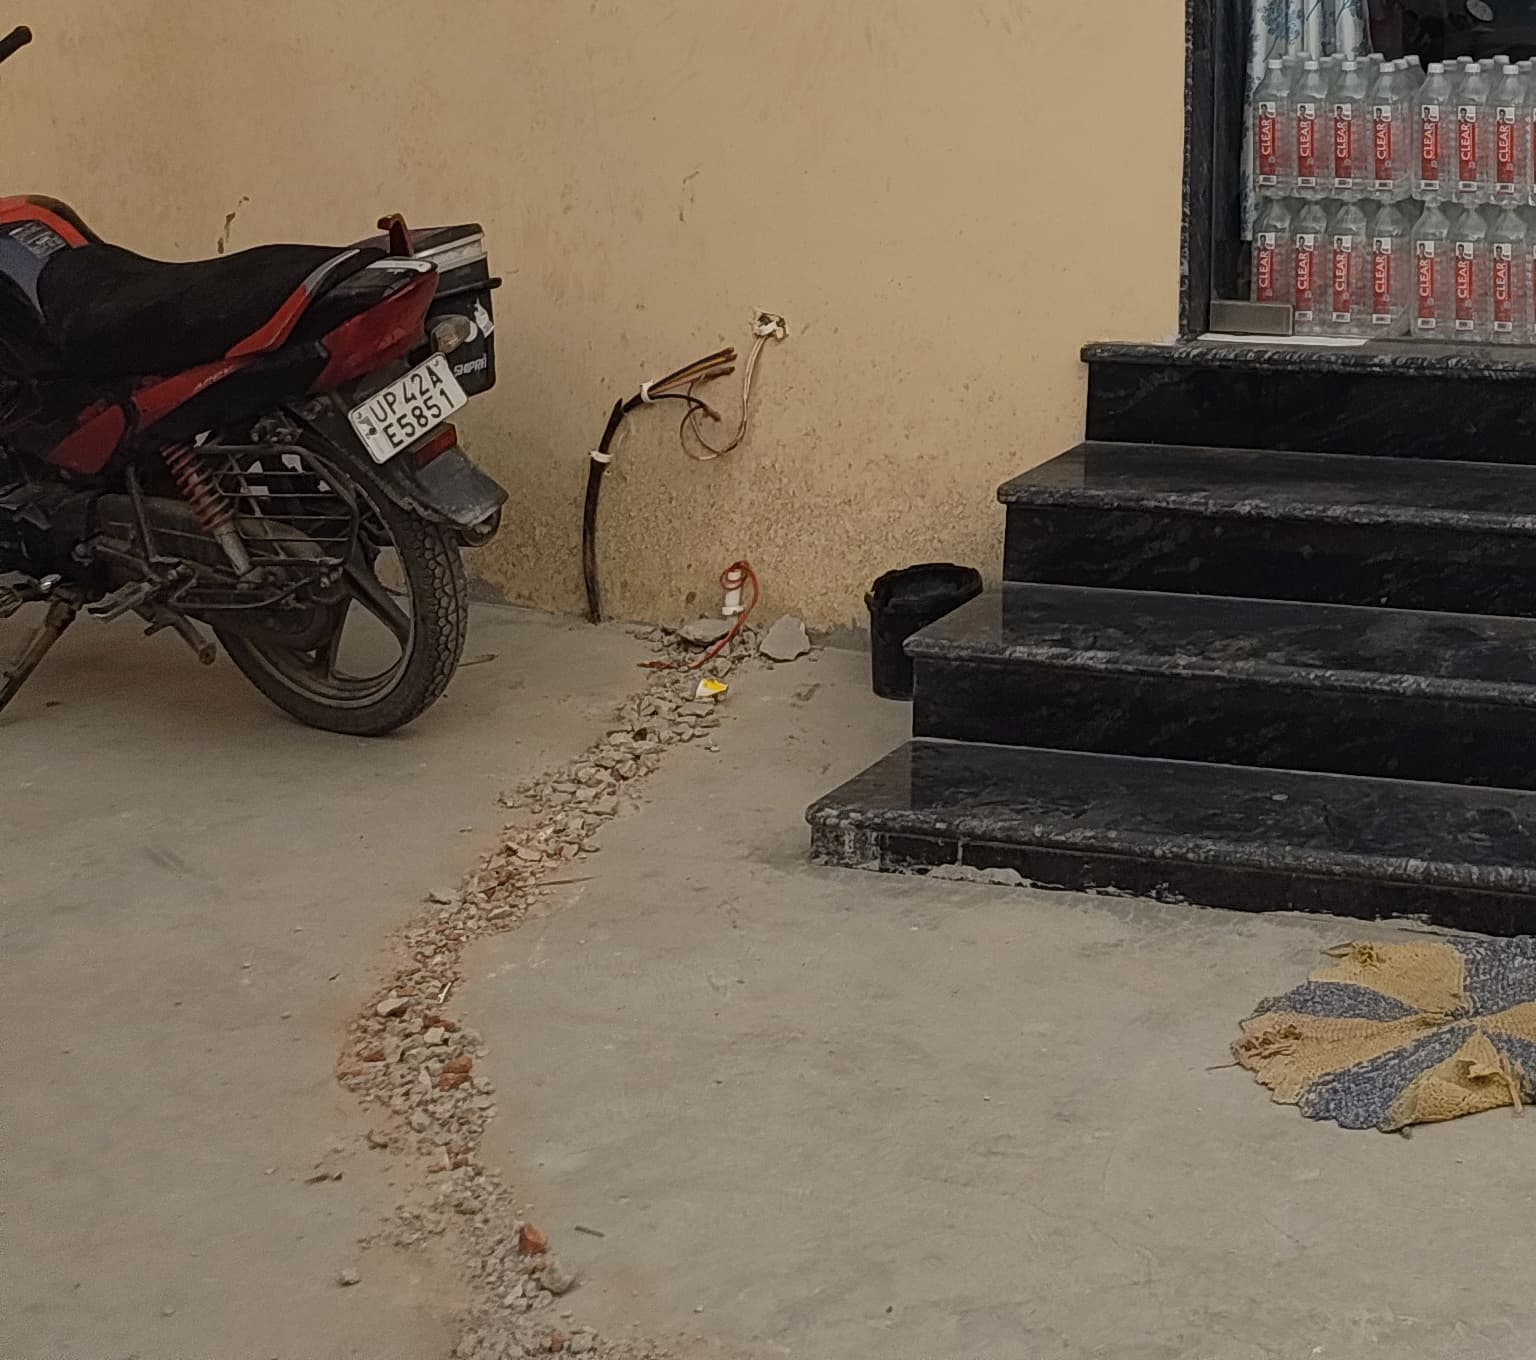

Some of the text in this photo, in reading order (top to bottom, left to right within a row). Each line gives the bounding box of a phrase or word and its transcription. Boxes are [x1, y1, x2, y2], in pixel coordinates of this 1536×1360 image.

[1261, 119, 1272, 155] CLEAR
[1300, 120, 1310, 157] CLEAR
[1336, 121, 1347, 158] CLEAR
[1376, 123, 1387, 159] CLEAR
[1423, 123, 1433, 159] CLEAR
[1461, 124, 1471, 160] CLEAR
[1499, 125, 1509, 162] CLEAR
[1259, 251, 1269, 287] CLEAR
[1298, 252, 1308, 290] CLEAR
[1335, 253, 1345, 291] CLEAR
[1375, 255, 1385, 293] CLEAR
[1419, 260, 1429, 296] CLEAR
[1457, 261, 1468, 298] CLEAR
[1496, 262, 1506, 300] CLEAR
[383, 387, 454, 448] E5851
